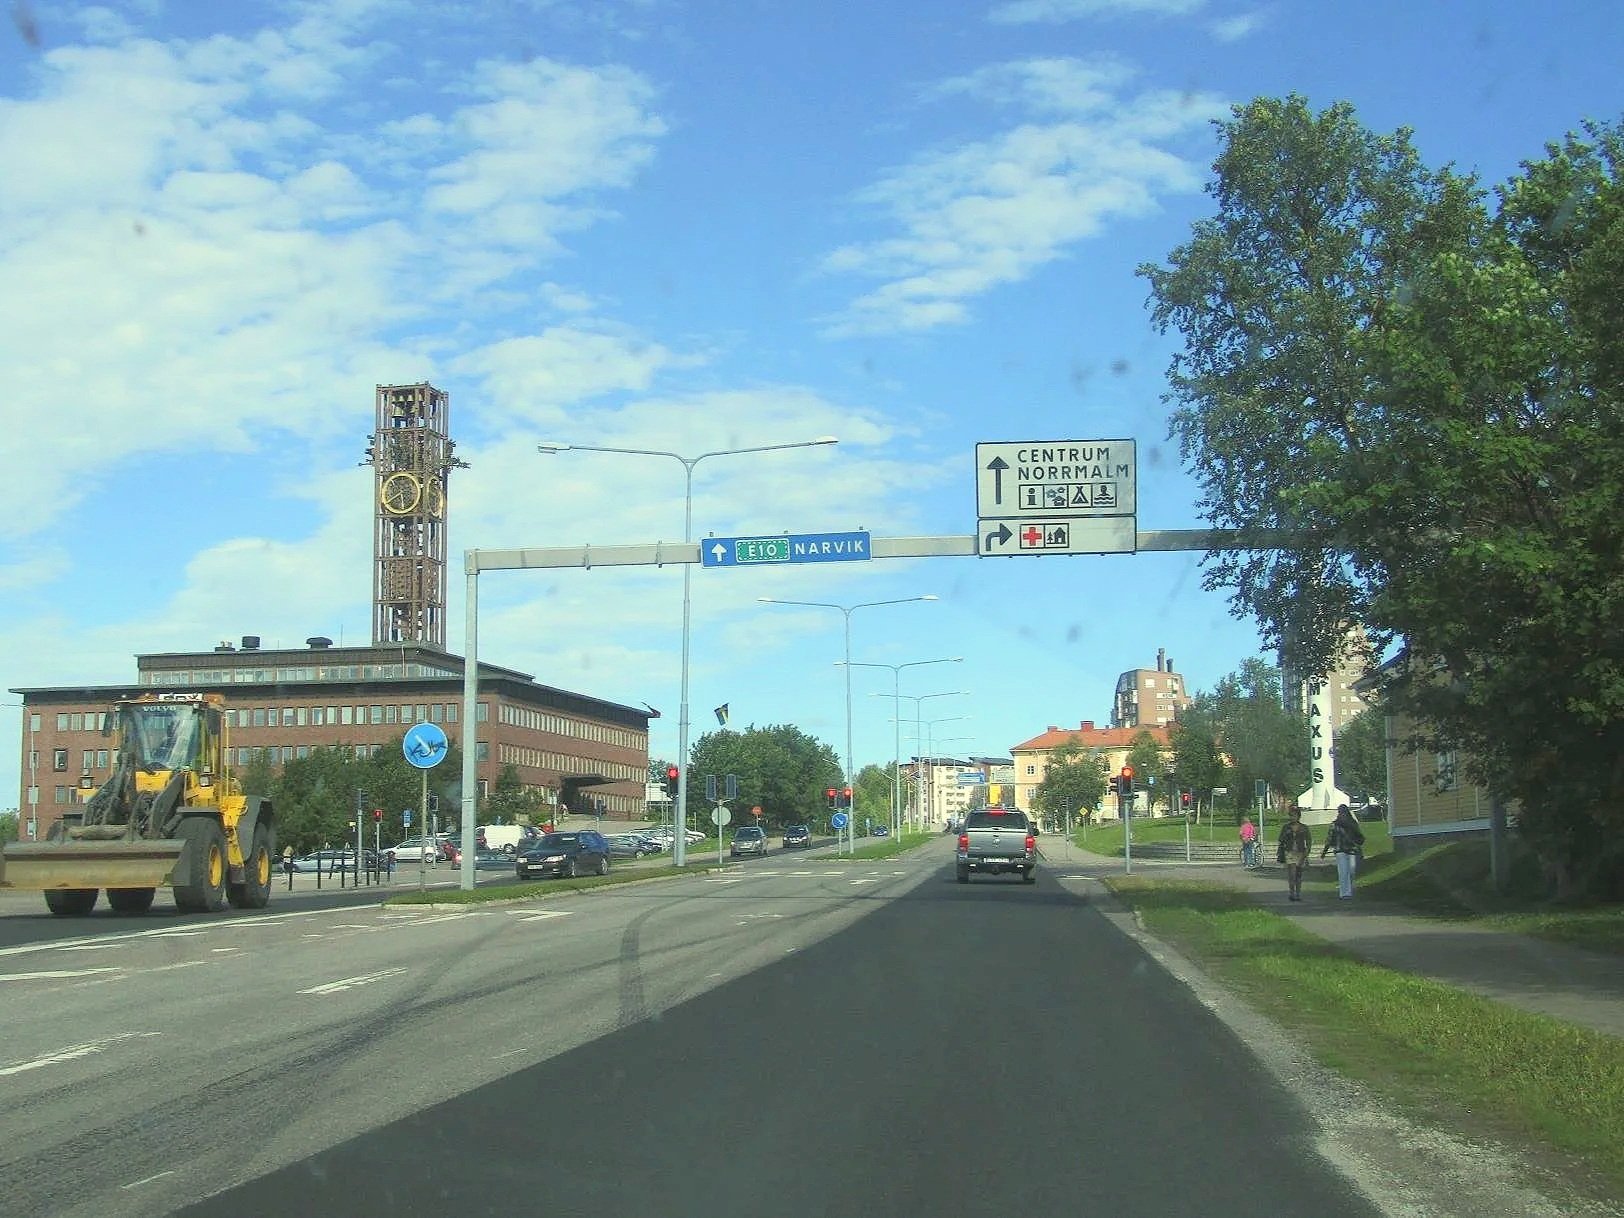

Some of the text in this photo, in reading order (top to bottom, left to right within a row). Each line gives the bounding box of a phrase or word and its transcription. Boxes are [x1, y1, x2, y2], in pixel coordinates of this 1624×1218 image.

[1017, 447, 1110, 463] CENTRUM
[1018, 464, 1129, 481] NORRMALM
[749, 544, 777, 557] E10
[795, 540, 864, 555] NARVIK
[1309, 682, 1324, 784] MAXUS
